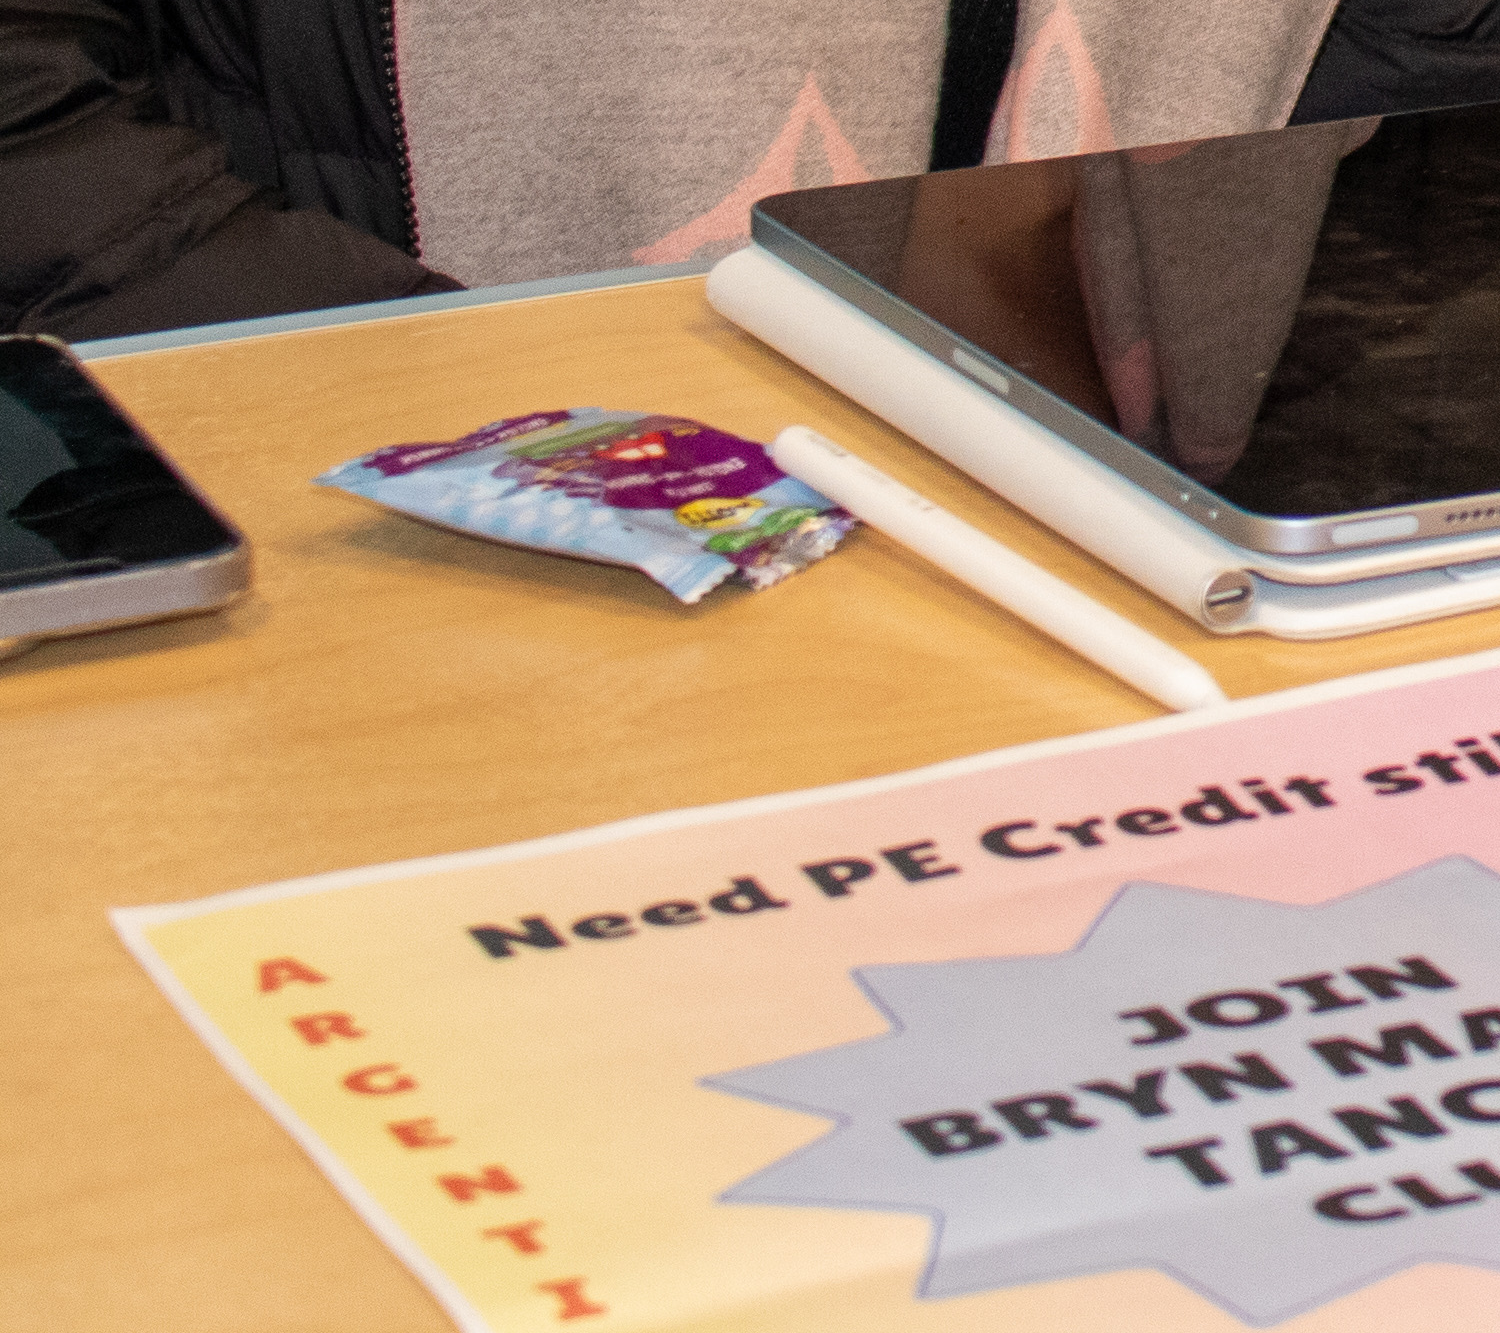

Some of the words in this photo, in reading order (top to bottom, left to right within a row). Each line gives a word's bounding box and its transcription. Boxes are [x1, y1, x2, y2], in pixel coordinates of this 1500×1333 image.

[467, 875, 790, 961] Need
[800, 839, 962, 899] PE
[979, 774, 1336, 860] Credit
[1115, 955, 1458, 1048] JOIN
[897, 1051, 1296, 1159] BRYN
